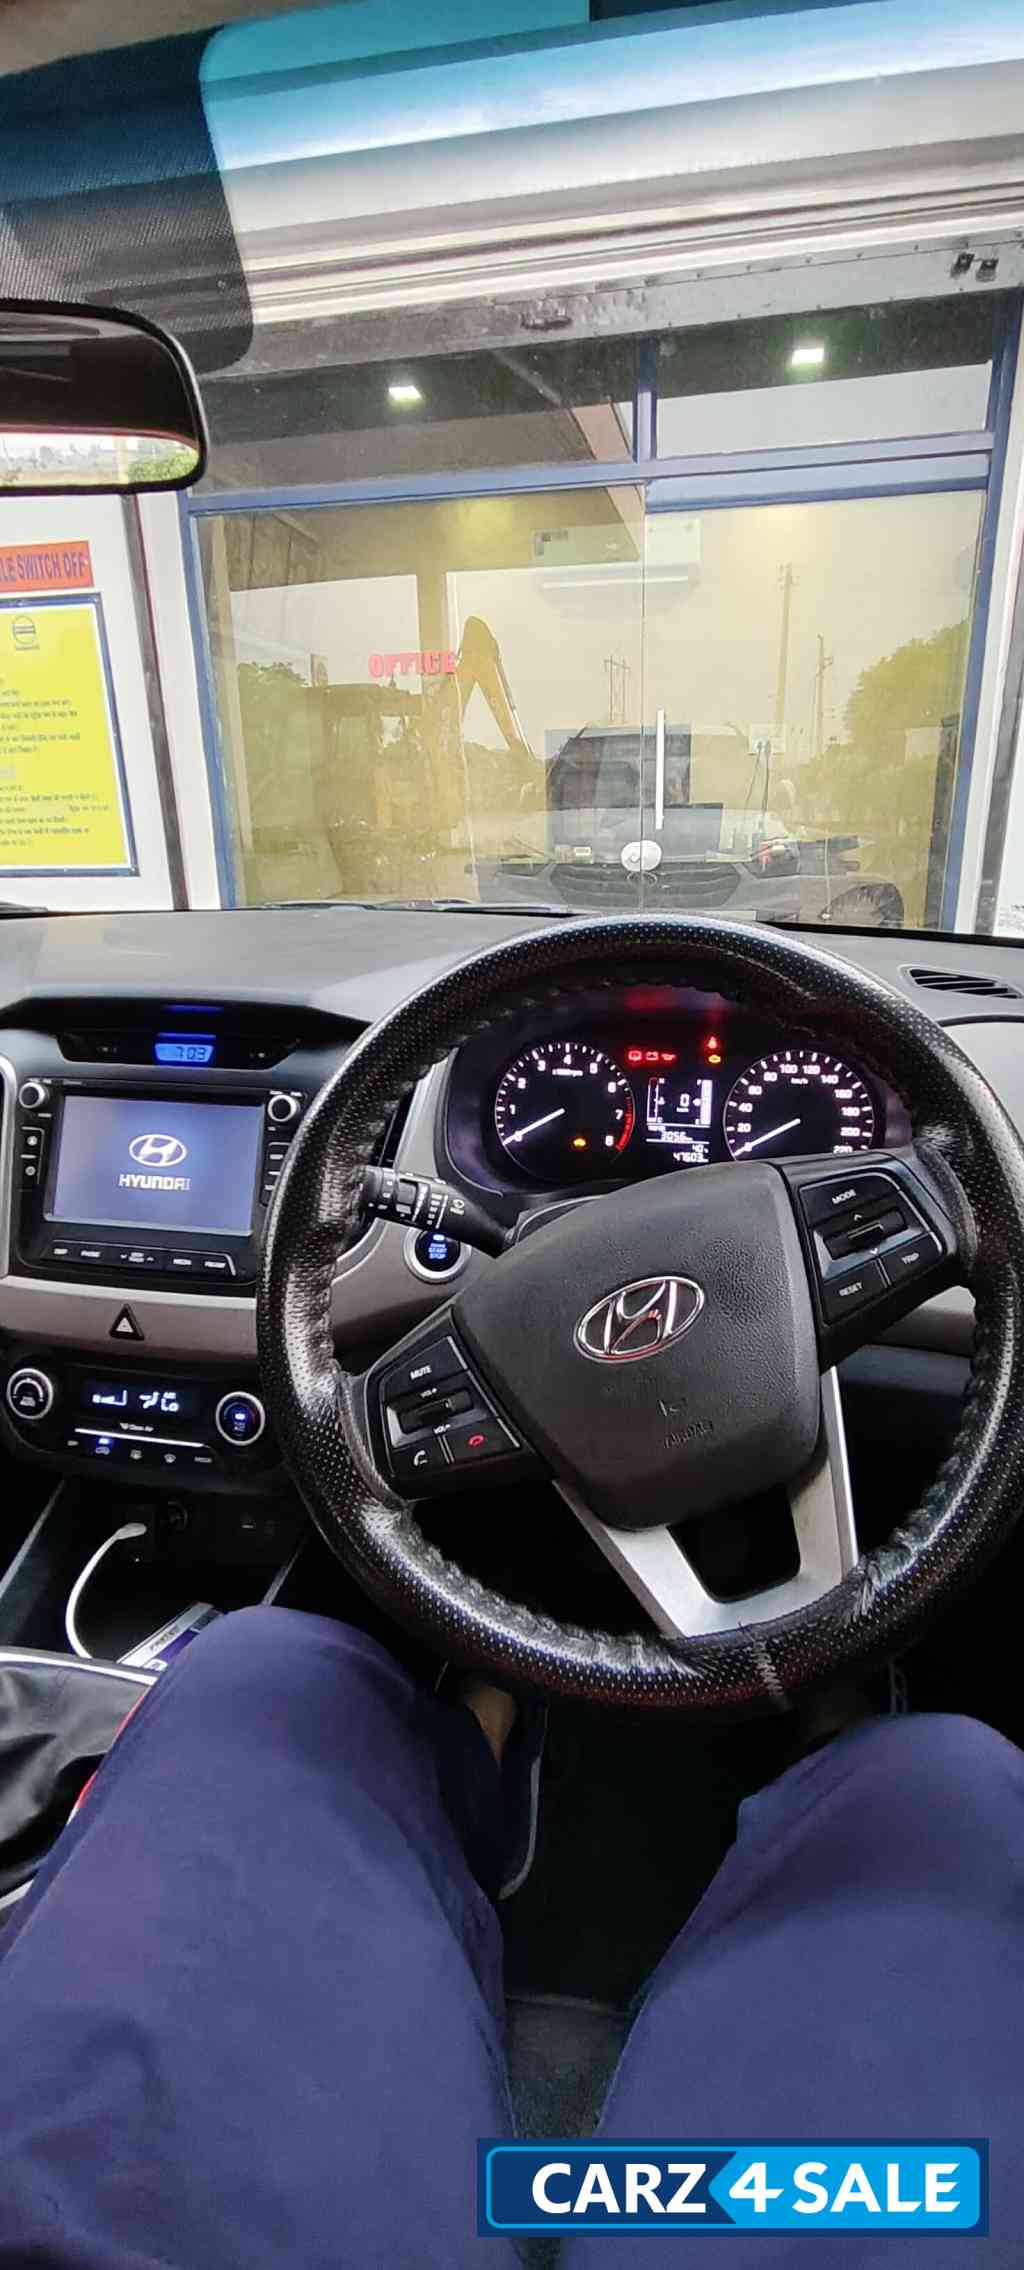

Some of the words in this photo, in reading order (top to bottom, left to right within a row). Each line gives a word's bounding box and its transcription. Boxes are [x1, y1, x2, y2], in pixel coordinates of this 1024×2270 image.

[16, 553, 61, 580] SWITCH
[63, 551, 85, 577] OFF
[367, 652, 456, 678] OFFICE
[563, 1055, 571, 1064] 4
[538, 1060, 546, 1071] 3
[589, 1062, 598, 1074] 5
[779, 1064, 798, 1074] 100
[802, 1065, 820, 1074] 120
[763, 1072, 777, 1082] 80
[820, 1075, 839, 1084] 140
[518, 1078, 526, 1089] 2
[607, 1081, 616, 1093] 6
[748, 1085, 762, 1095] 60
[834, 1089, 853, 1099] 160
[680, 1094, 690, 1107] 0
[509, 1104, 516, 1115] 1
[738, 1102, 753, 1112] 40
[841, 1107, 860, 1116] 180
[615, 1109, 623, 1120] 7
[737, 1122, 752, 1133] 20
[840, 1127, 860, 1137] 200
[604, 1135, 614, 1147] 8
[118, 1173, 192, 1191] HYUNDAI
[832, 1188, 857, 1205] MODE
[901, 1252, 920, 1265] TRIP
[838, 1281, 863, 1297] RESET
[410, 1364, 433, 1380] MUTE
